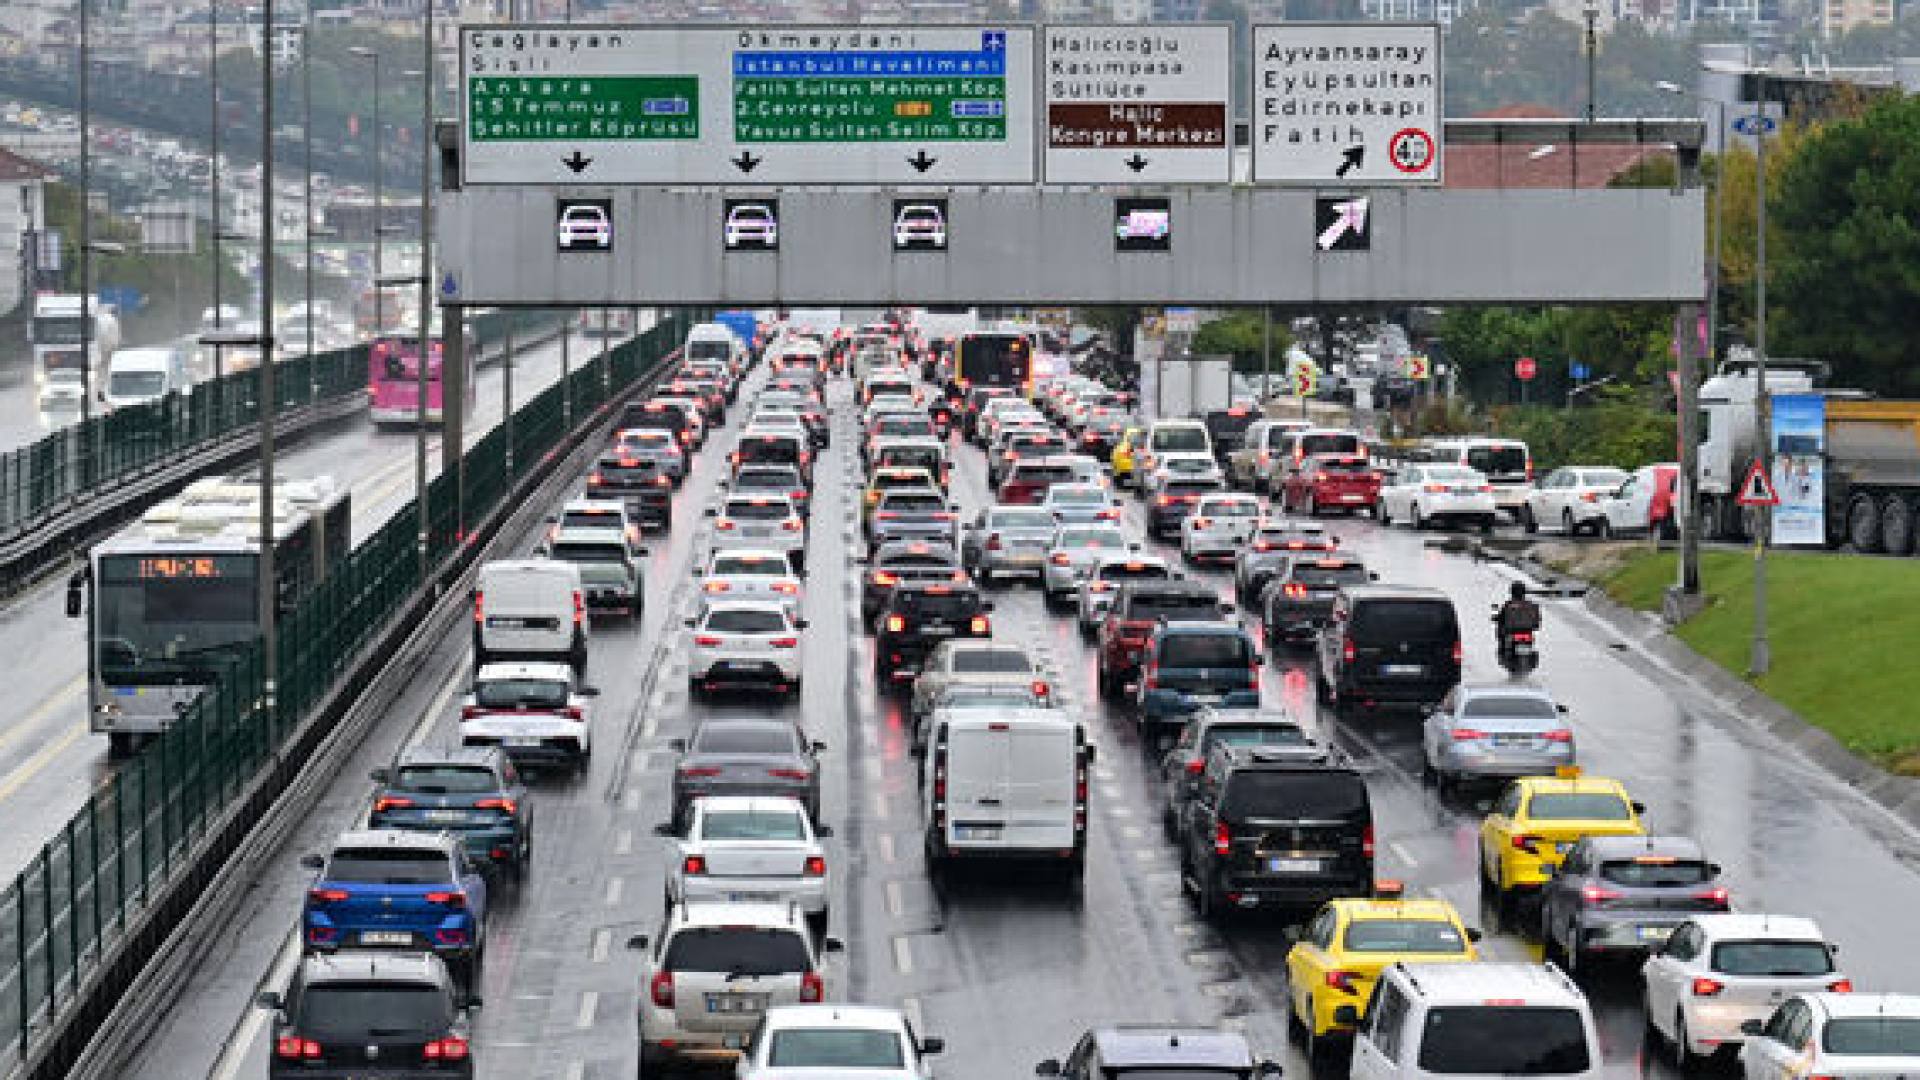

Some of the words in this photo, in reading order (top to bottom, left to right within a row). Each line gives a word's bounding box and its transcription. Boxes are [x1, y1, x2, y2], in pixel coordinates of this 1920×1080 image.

[1265, 42, 1427, 65] Ayvansaray
[474, 80, 592, 96] Ankara
[736, 80, 788, 96] Fatih
[796, 80, 863, 96] Sultan
[870, 80, 953, 96] Mehmet
[1265, 70, 1432, 95] Eyüpsultan
[512, 97, 622, 114] Temmuz
[1265, 97, 1425, 119] Edirnekapı
[737, 122, 802, 139] Yavuz
[809, 121, 882, 138] Sultan
[888, 121, 950, 138] Selim
[1052, 126, 1128, 146] Kongre
[1136, 126, 1223, 143] Merkezi
[1265, 124, 1364, 143] Fatih
